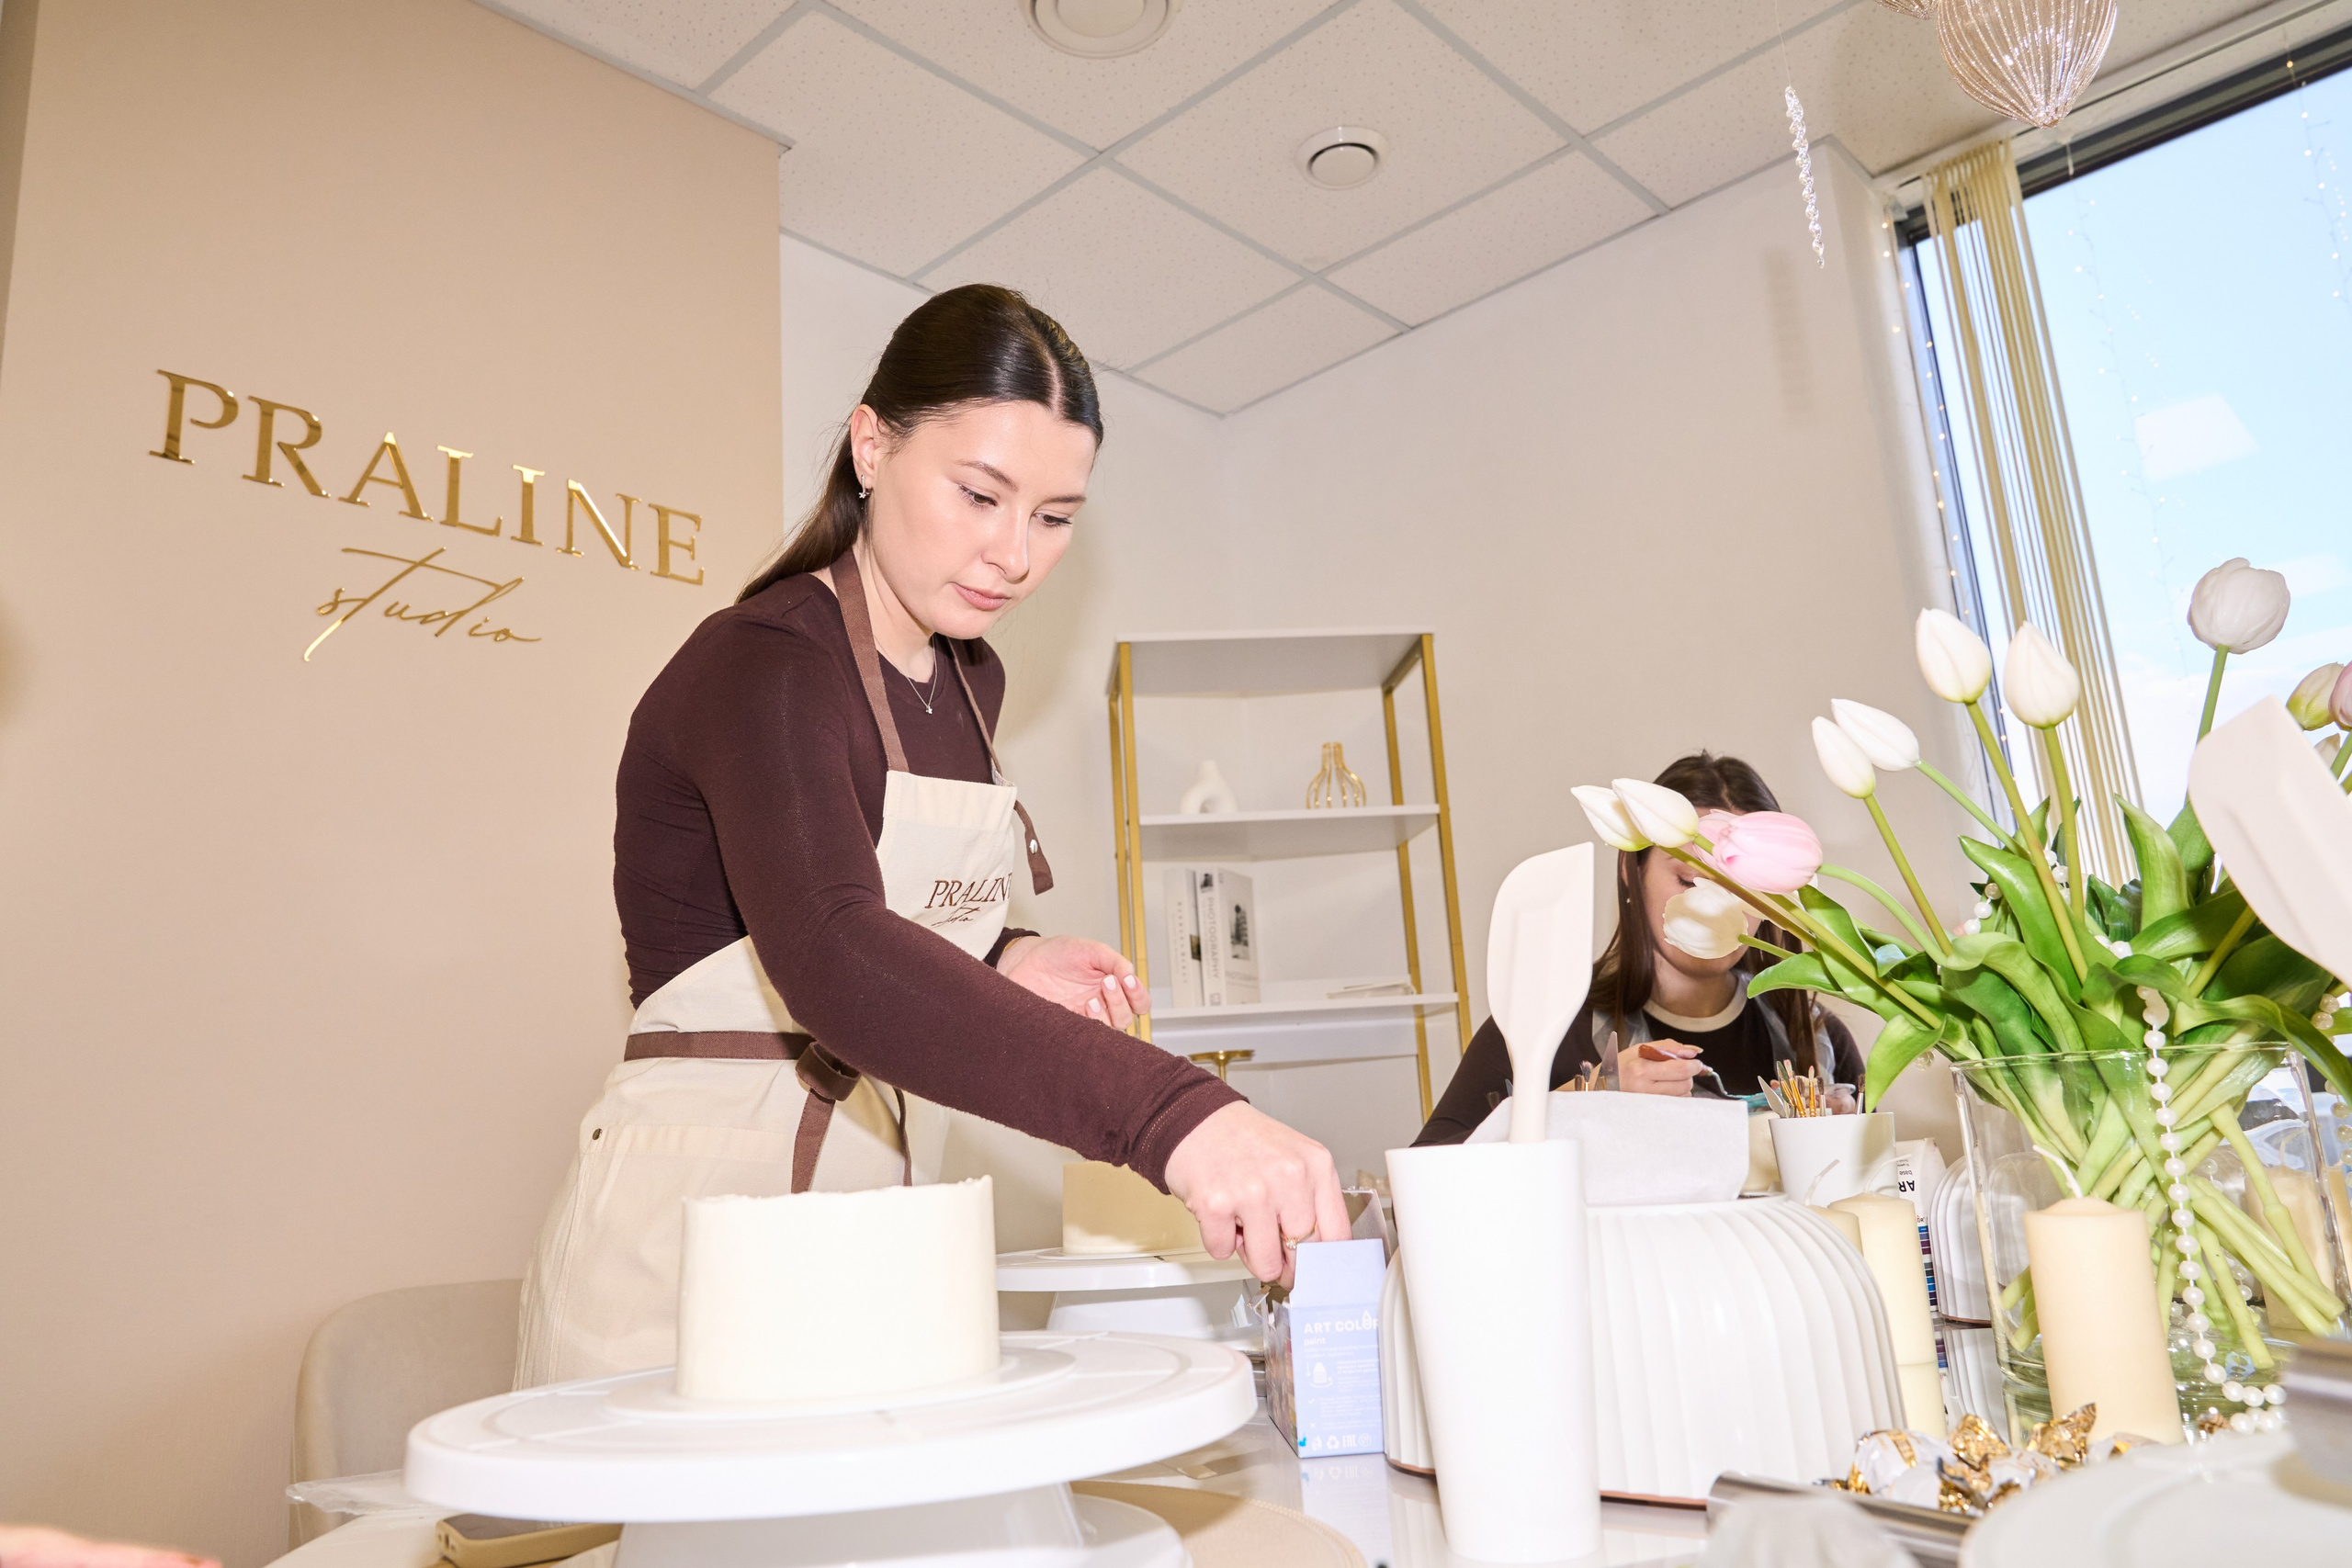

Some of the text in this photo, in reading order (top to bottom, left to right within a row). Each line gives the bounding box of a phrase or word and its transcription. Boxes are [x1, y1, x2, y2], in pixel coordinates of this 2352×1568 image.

[149, 369, 705, 586] PRALINE
[303, 547, 542, 661] studio
[923, 873, 1012, 908] PRALIN
[1898, 1180, 1915, 1191] AR
[1304, 1321, 1331, 1334] ART
[1304, 1337, 1326, 1347] paint
